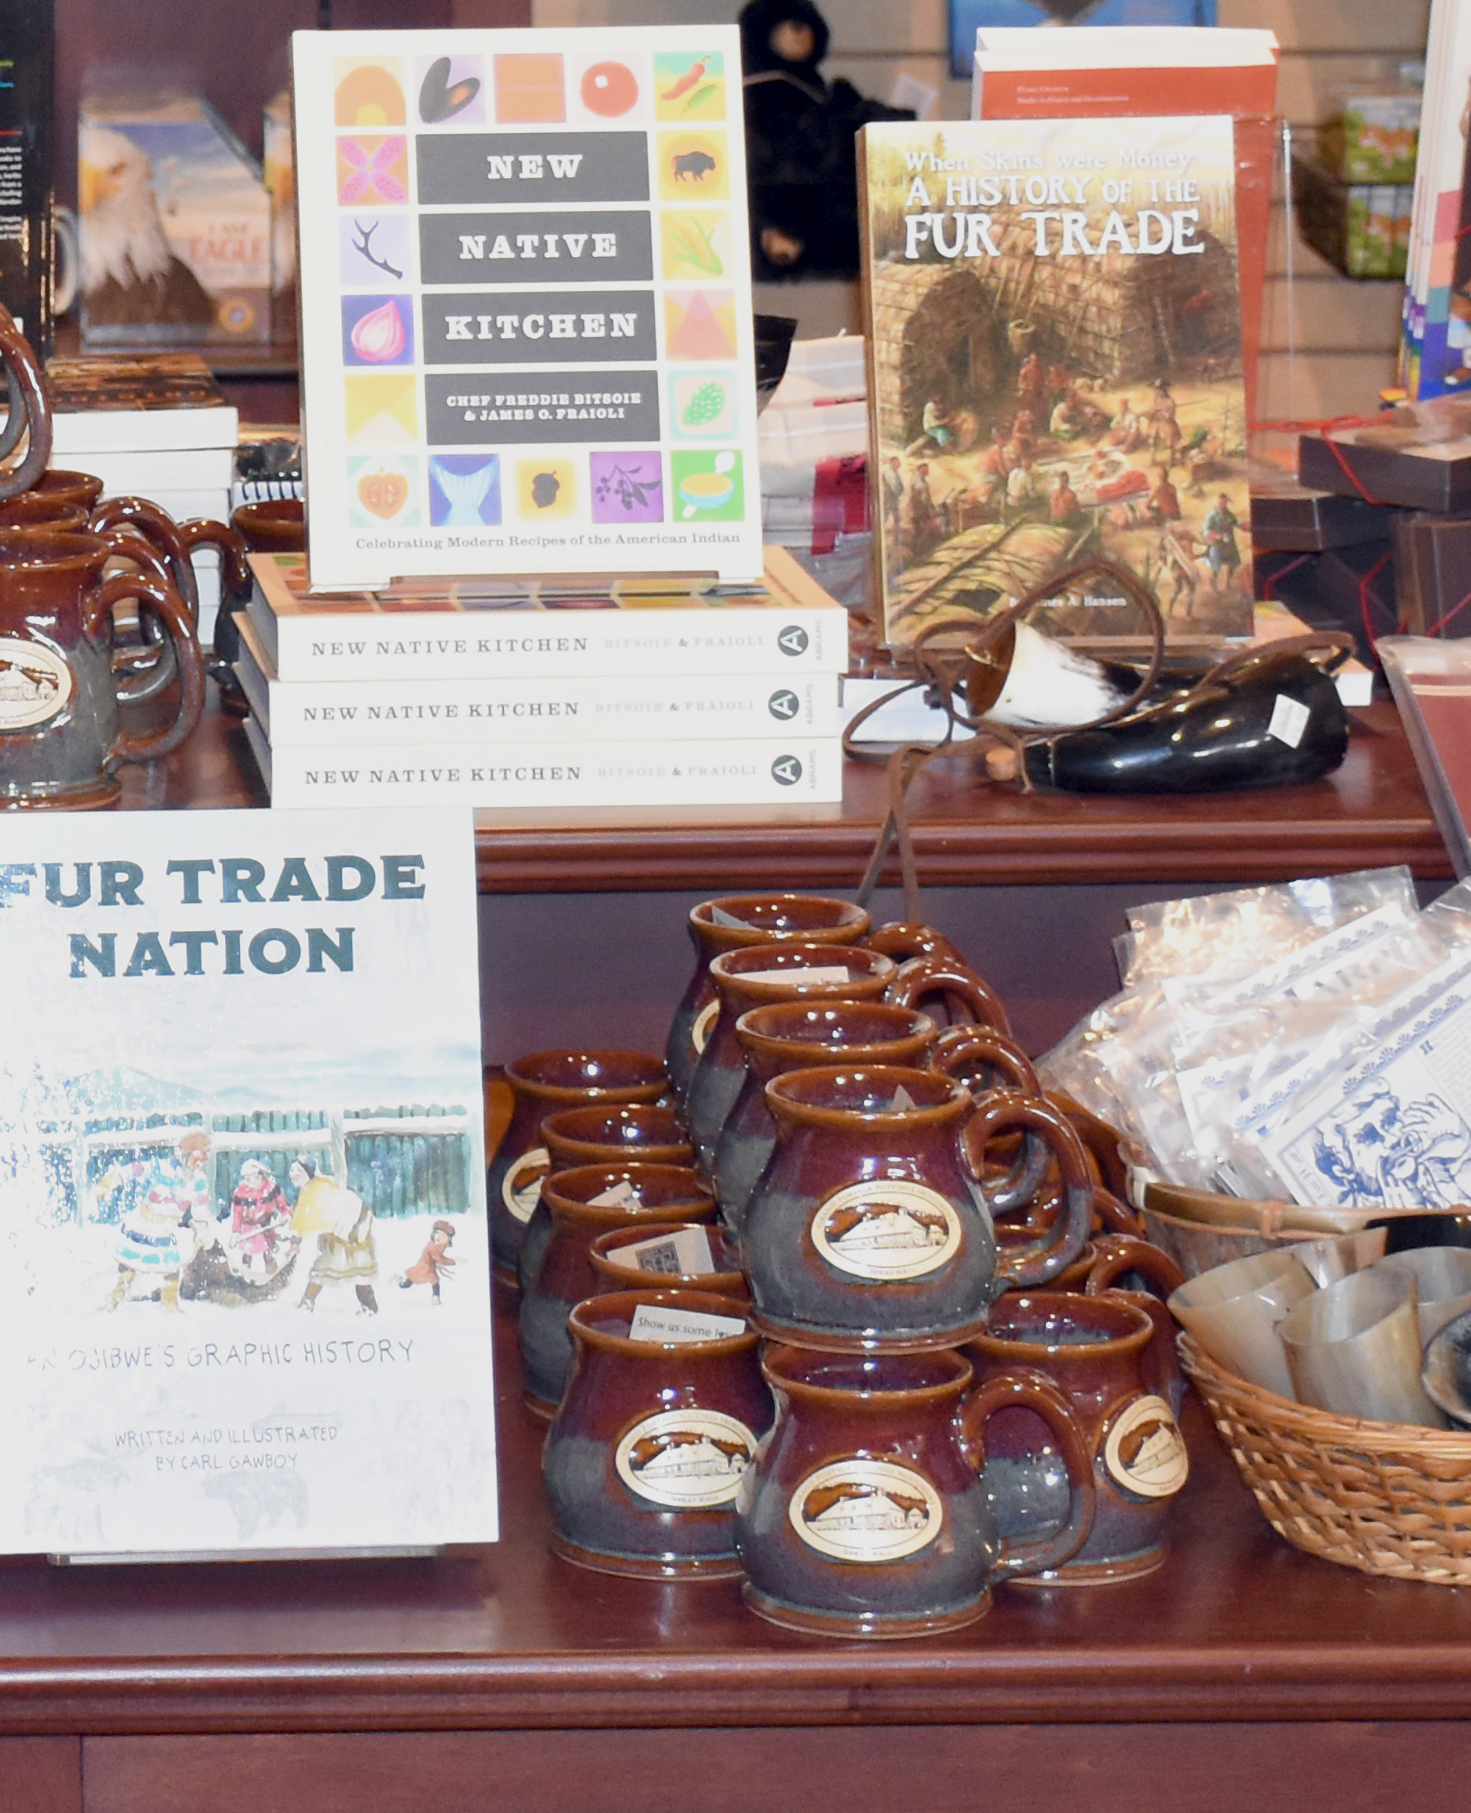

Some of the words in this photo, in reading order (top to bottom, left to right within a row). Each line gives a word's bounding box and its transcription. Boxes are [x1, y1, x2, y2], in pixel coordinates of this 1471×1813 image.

[486, 153, 583, 180] NEW
[904, 150, 971, 173] When
[981, 148, 1045, 171] Skins
[1055, 153, 1108, 170] were
[905, 177, 932, 207] A
[945, 174, 1095, 207] HISTORY
[1101, 178, 1132, 204] OF
[1147, 178, 1201, 204] THE
[904, 211, 1001, 260] FUR
[1020, 207, 1205, 257] TRADE
[458, 232, 618, 260] NATIVE
[444, 312, 638, 341] KITCHEN
[445, 394, 492, 408] CHEF
[494, 393, 570, 407] FREDDIE
[573, 392, 642, 406] BITSOIE
[463, 409, 477, 422] &
[479, 408, 535, 422] JAMES
[555, 407, 626, 421] FRAIOLI
[355, 537, 444, 551] Celebrating
[447, 535, 505, 549] Modern
[508, 535, 567, 551] Recipes
[569, 534, 585, 546] of
[588, 533, 612, 546] the
[614, 532, 688, 546] American
[691, 531, 741, 545] Indian
[311, 641, 367, 657] NEW
[375, 638, 468, 655] NATIVE
[476, 636, 588, 654] KITCHEN
[677, 637, 689, 648] &
[302, 706, 359, 722] NEW
[366, 704, 460, 721] NATIVE
[468, 701, 580, 718] KITCHEN
[669, 702, 680, 712] &
[304, 770, 361, 786] NEW
[368, 768, 462, 784] NATIVE
[470, 765, 582, 782] KITCHEN
[671, 766, 682, 777] &
[165, 853, 427, 906] TRADE
[66, 926, 356, 979] NATION
[637, 1316, 665, 1331] Show
[667, 1322, 680, 1332] us
[682, 1324, 712, 1337] some
[186, 1342, 293, 1369] GRAPHIC
[303, 1338, 414, 1365] HISTORY
[114, 1429, 185, 1448] WRITTEN
[190, 1428, 223, 1445] AND
[227, 1425, 338, 1446] ILLUSTRATED
[155, 1455, 176, 1472] BY
[181, 1454, 223, 1471] CARL
[228, 1452, 298, 1470] GAWBOY
